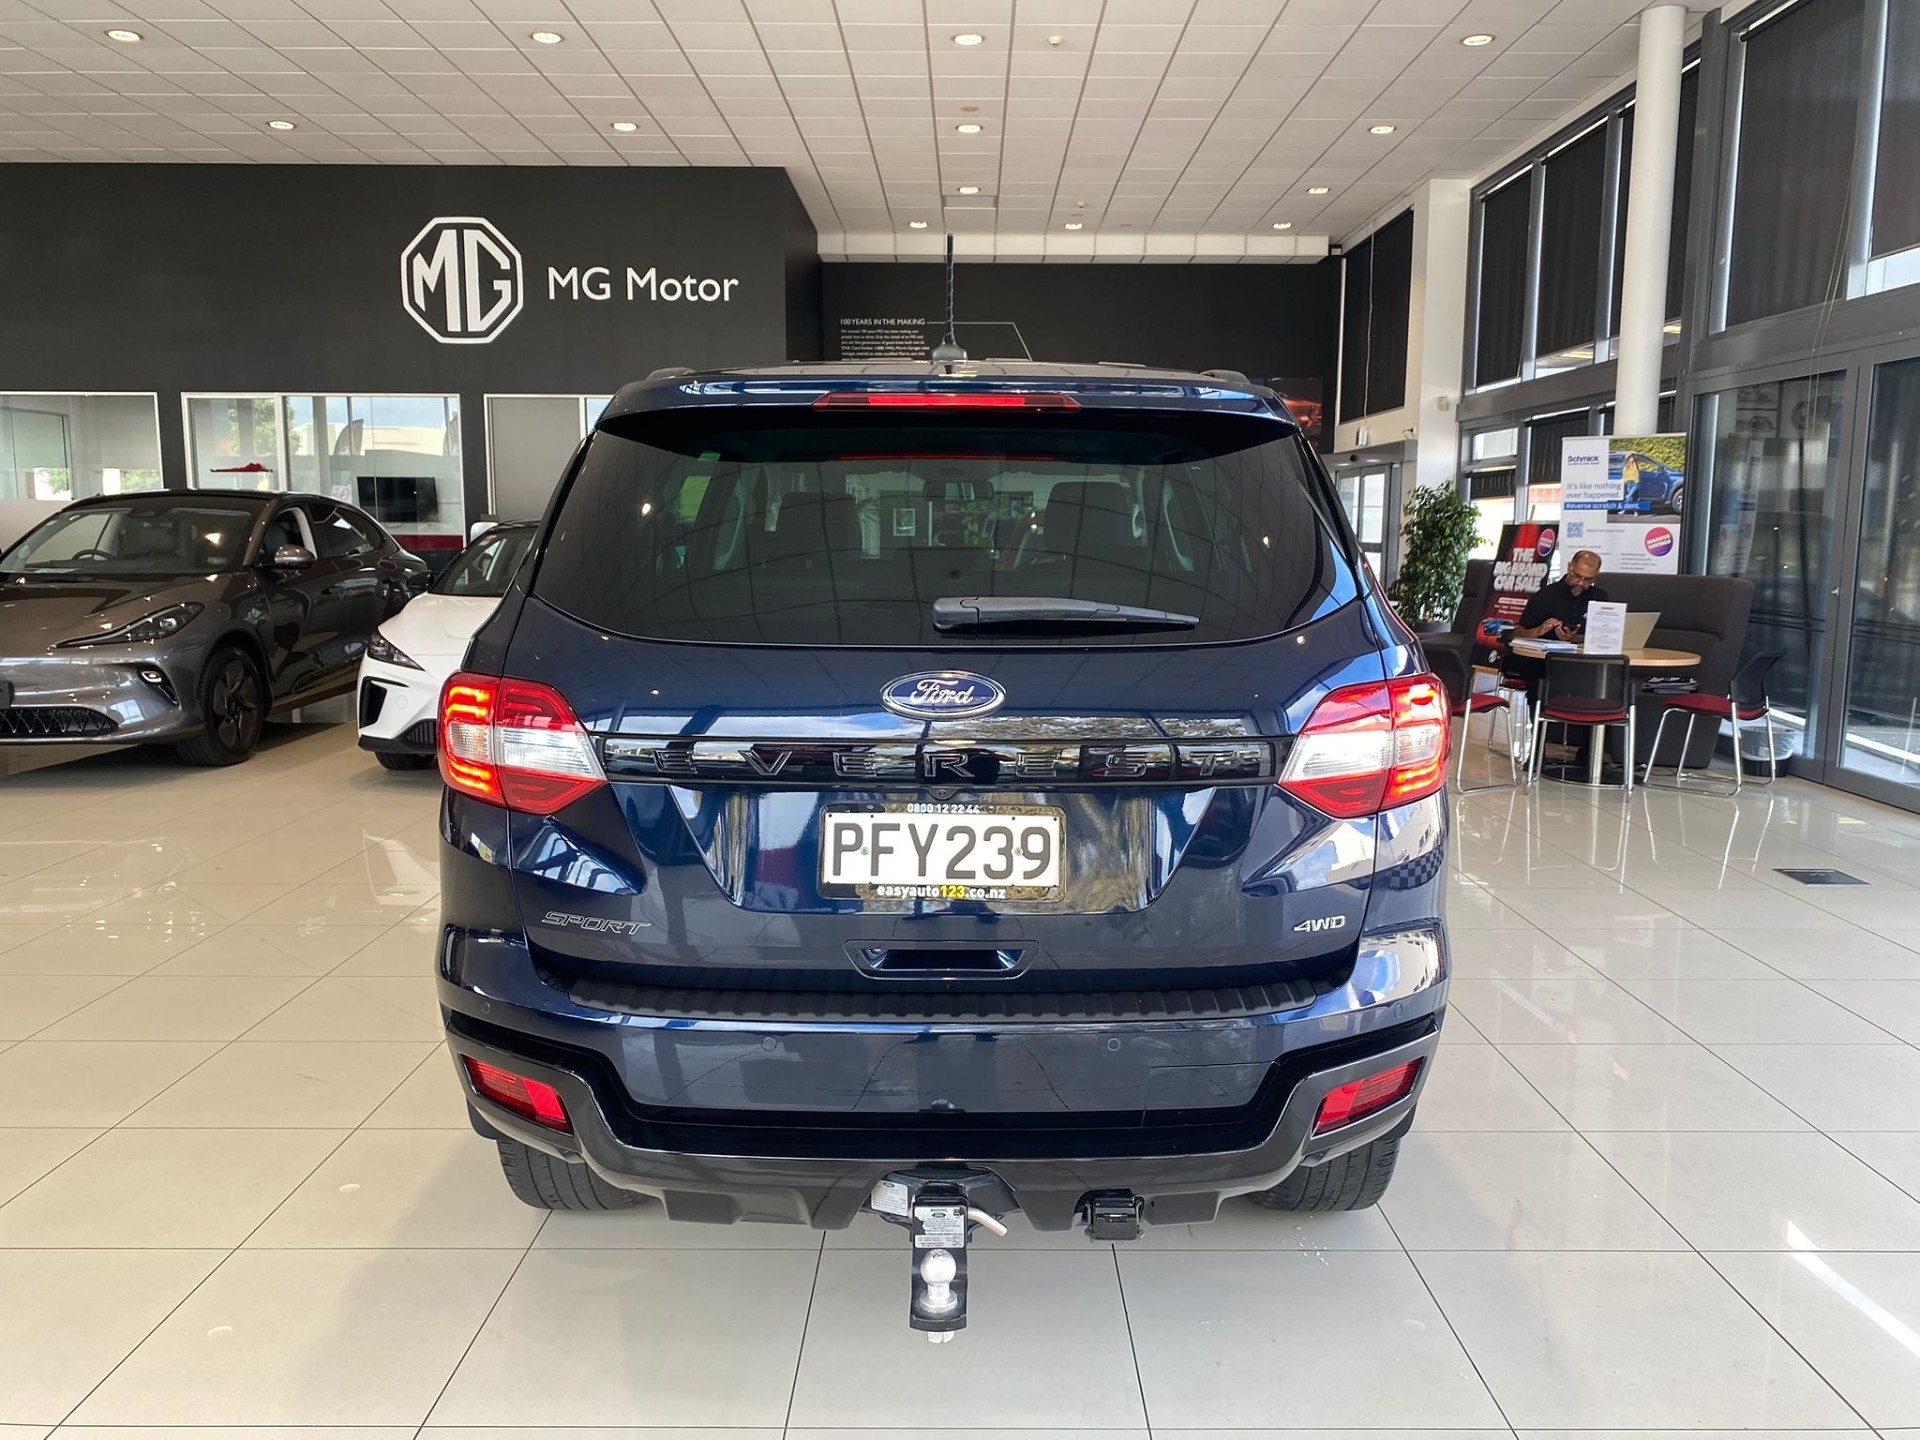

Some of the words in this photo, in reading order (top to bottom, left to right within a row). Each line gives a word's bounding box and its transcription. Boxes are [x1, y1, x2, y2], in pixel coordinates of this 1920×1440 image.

[412, 228, 512, 332] MG
[548, 267, 612, 301] MG
[626, 267, 740, 302] Motor
[840, 318, 852, 326] 100
[852, 318, 873, 326] YEARS
[873, 318, 882, 326] IN
[882, 318, 896, 326] THE
[896, 318, 926, 326] MAKING
[1567, 455, 1600, 463] Schmick
[1583, 492, 1622, 500] happened.
[1593, 483, 1622, 492] nothing
[1566, 502, 1592, 510] Reverse
[1592, 502, 1617, 510] scratch
[1513, 548, 1536, 562] THE
[1493, 561, 1512, 577] BIG
[1511, 562, 1548, 579] BRAND
[1494, 575, 1515, 591] CAR
[1513, 576, 1542, 593] SALE
[909, 679, 975, 705] Ford
[652, 749, 1235, 778] EVEREST
[906, 803, 934, 814] 0800
[936, 804, 949, 814] 12
[950, 804, 964, 814] 22
[964, 804, 981, 815] 44
[832, 822, 1051, 880] PFY239
[876, 885, 1006, 900] easyauto123.co.nz
[541, 910, 652, 935] SPORT
[1293, 915, 1346, 933] 4WD
